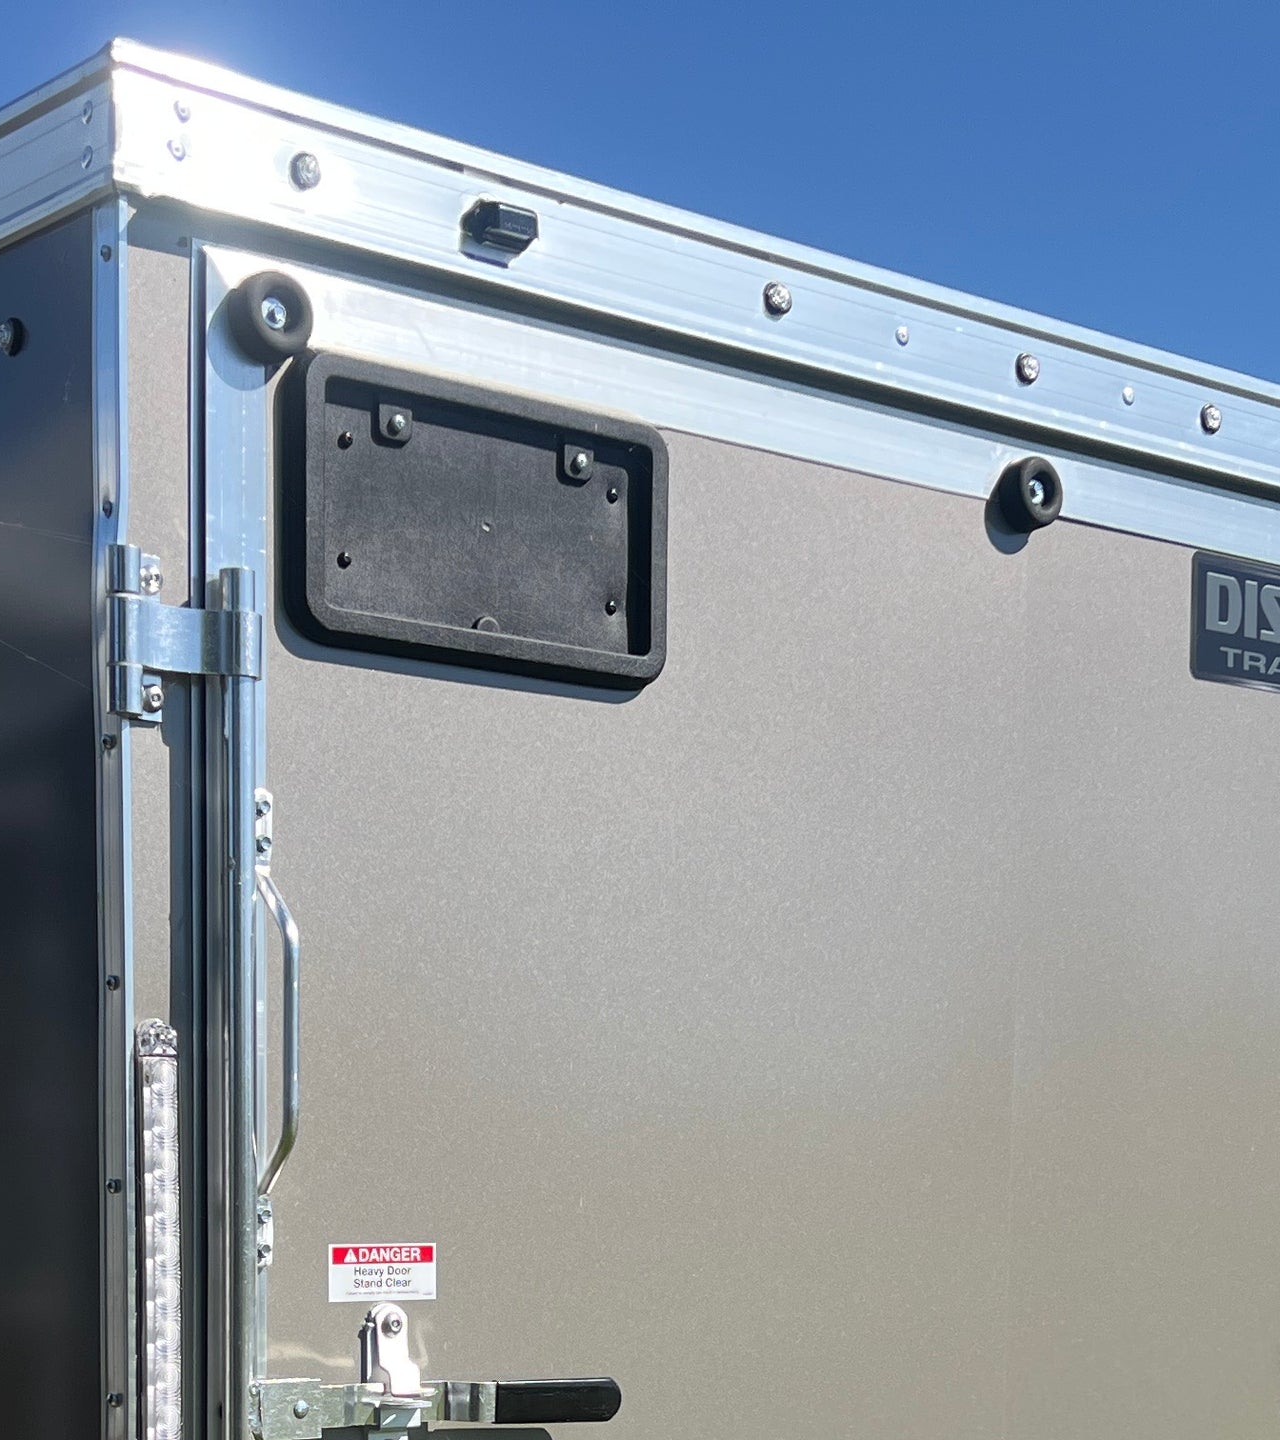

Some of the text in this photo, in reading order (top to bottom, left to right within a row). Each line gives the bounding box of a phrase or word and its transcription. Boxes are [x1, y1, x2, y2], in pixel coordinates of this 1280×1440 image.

[358, 1247, 421, 1263] DANGER
[353, 1265, 411, 1277] Heavy Door
[353, 1277, 411, 1288] Stand Clear
